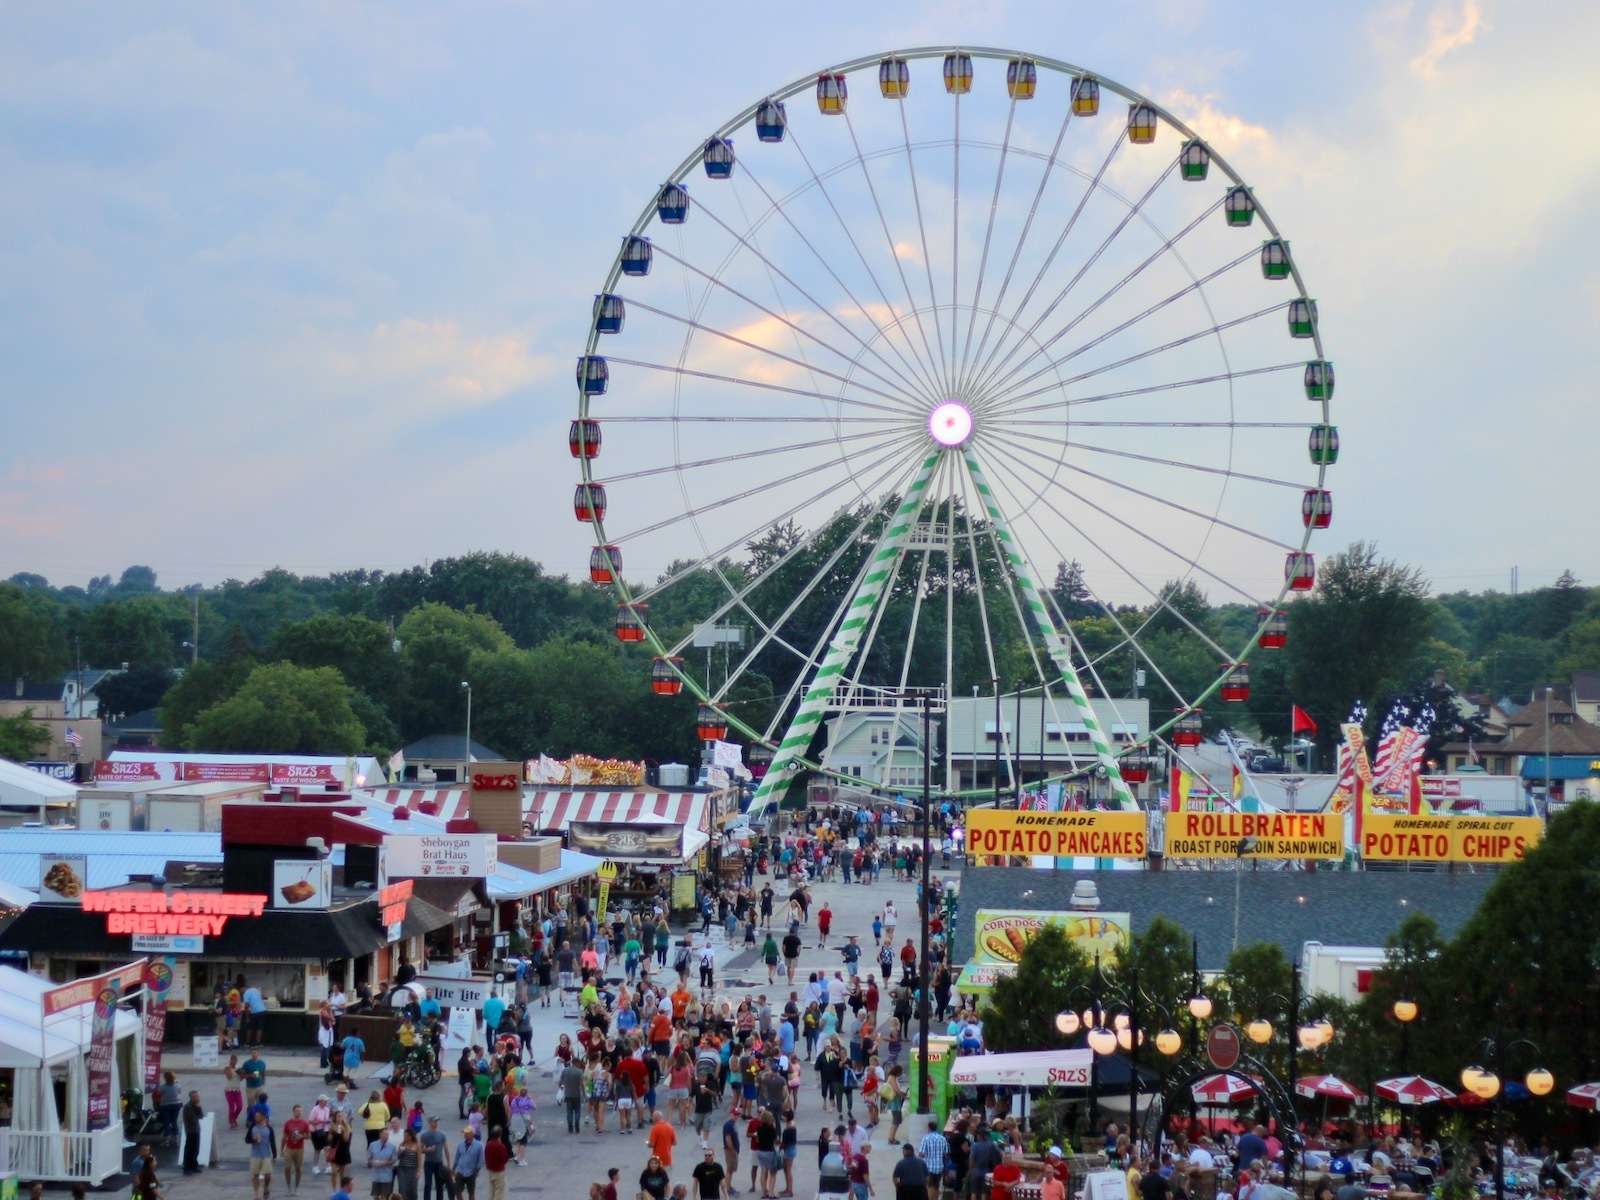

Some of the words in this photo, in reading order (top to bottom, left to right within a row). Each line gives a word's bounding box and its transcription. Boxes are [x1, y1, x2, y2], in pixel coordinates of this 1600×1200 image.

[112, 762, 141, 774] SAZ'S
[288, 765, 317, 777] SAZ'S
[472, 774, 517, 791] SAZ'S
[1016, 815, 1096, 826] HOMEMADE
[1187, 814, 1325, 838] ROLLBRATEN
[1394, 820, 1452, 829] HOMEMADE
[1457, 821, 1490, 830] SPIRAL
[1494, 822, 1514, 830] CUT
[421, 837, 470, 850] Sheboygan
[969, 829, 1052, 853] POTATO
[1057, 831, 1144, 855] PANCAKES
[1169, 840, 1211, 855] (ROAST
[1214, 840, 1241, 853] POR
[1278, 840, 1342, 856] SANDWICH)
[1365, 833, 1449, 857] POTATO
[1463, 834, 1526, 858] CHIPS
[423, 850, 442, 859] Brat
[444, 850, 468, 859] Haus
[81, 891, 167, 913] WATER
[171, 893, 268, 916] STREET
[108, 913, 228, 936] BREWERY
[983, 919, 1012, 932] CORN
[1015, 919, 1044, 929] DOGS
[434, 987, 454, 1000] Lite
[460, 988, 480, 1002] Lite
[954, 1073, 977, 1083] SAZ'S
[1048, 1067, 1087, 1083] SAZ'S
